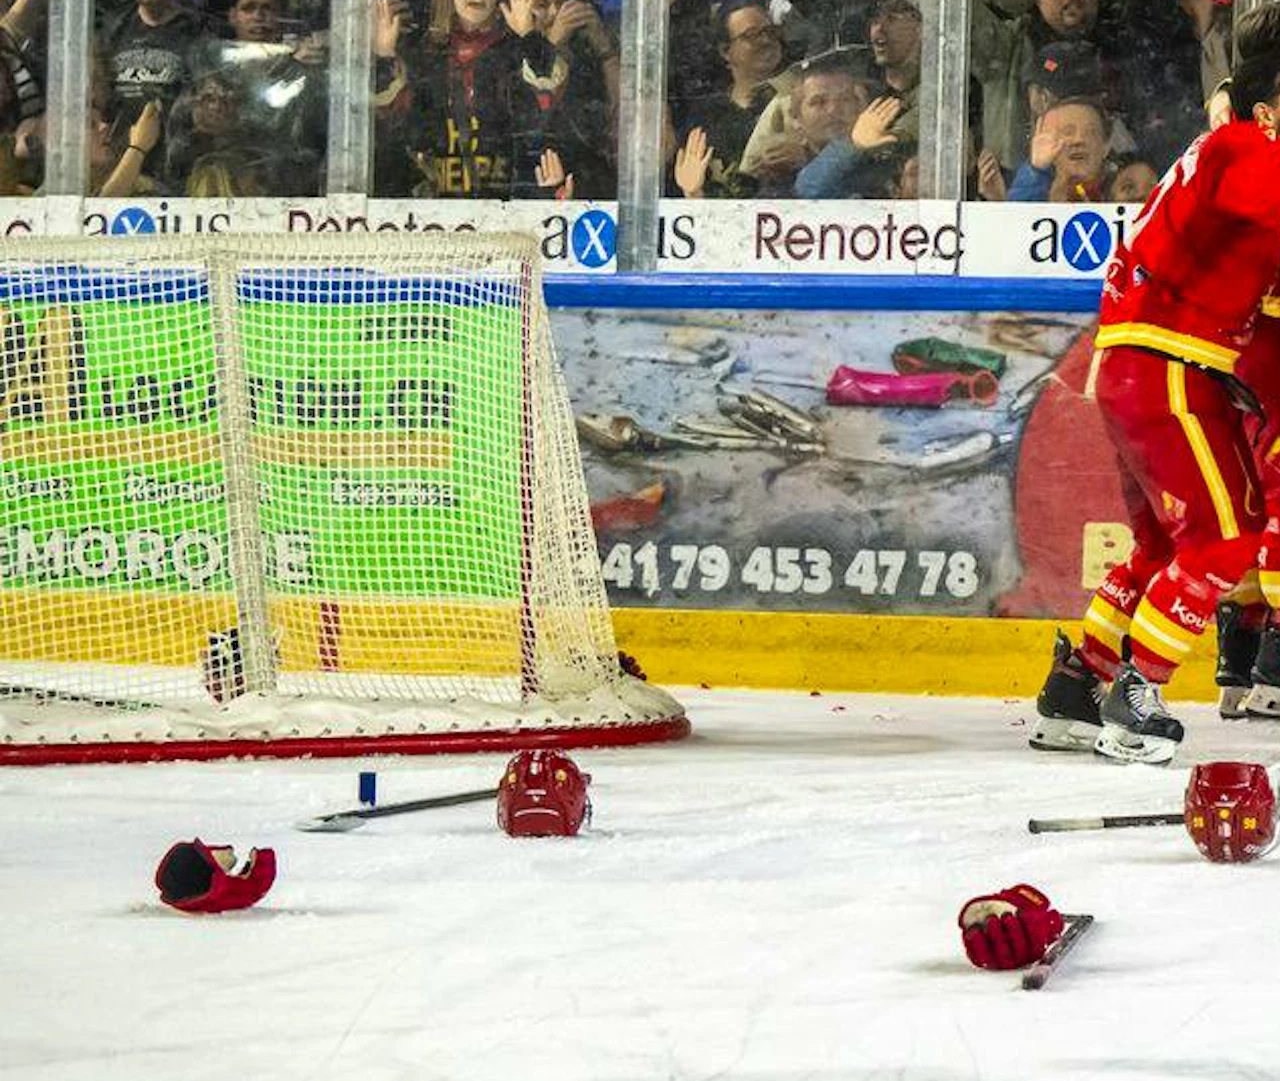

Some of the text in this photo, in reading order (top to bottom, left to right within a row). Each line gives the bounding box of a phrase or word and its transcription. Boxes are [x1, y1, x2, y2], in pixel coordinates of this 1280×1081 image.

[541, 208, 696, 269] axs
[755, 211, 965, 263] Renotec
[1030, 205, 1128, 272] axi
[0, 524, 312, 589] MORQE
[669, 545, 731, 591] 79
[741, 545, 833, 594] 453
[844, 549, 906, 596] 47
[918, 551, 979, 598] 78
